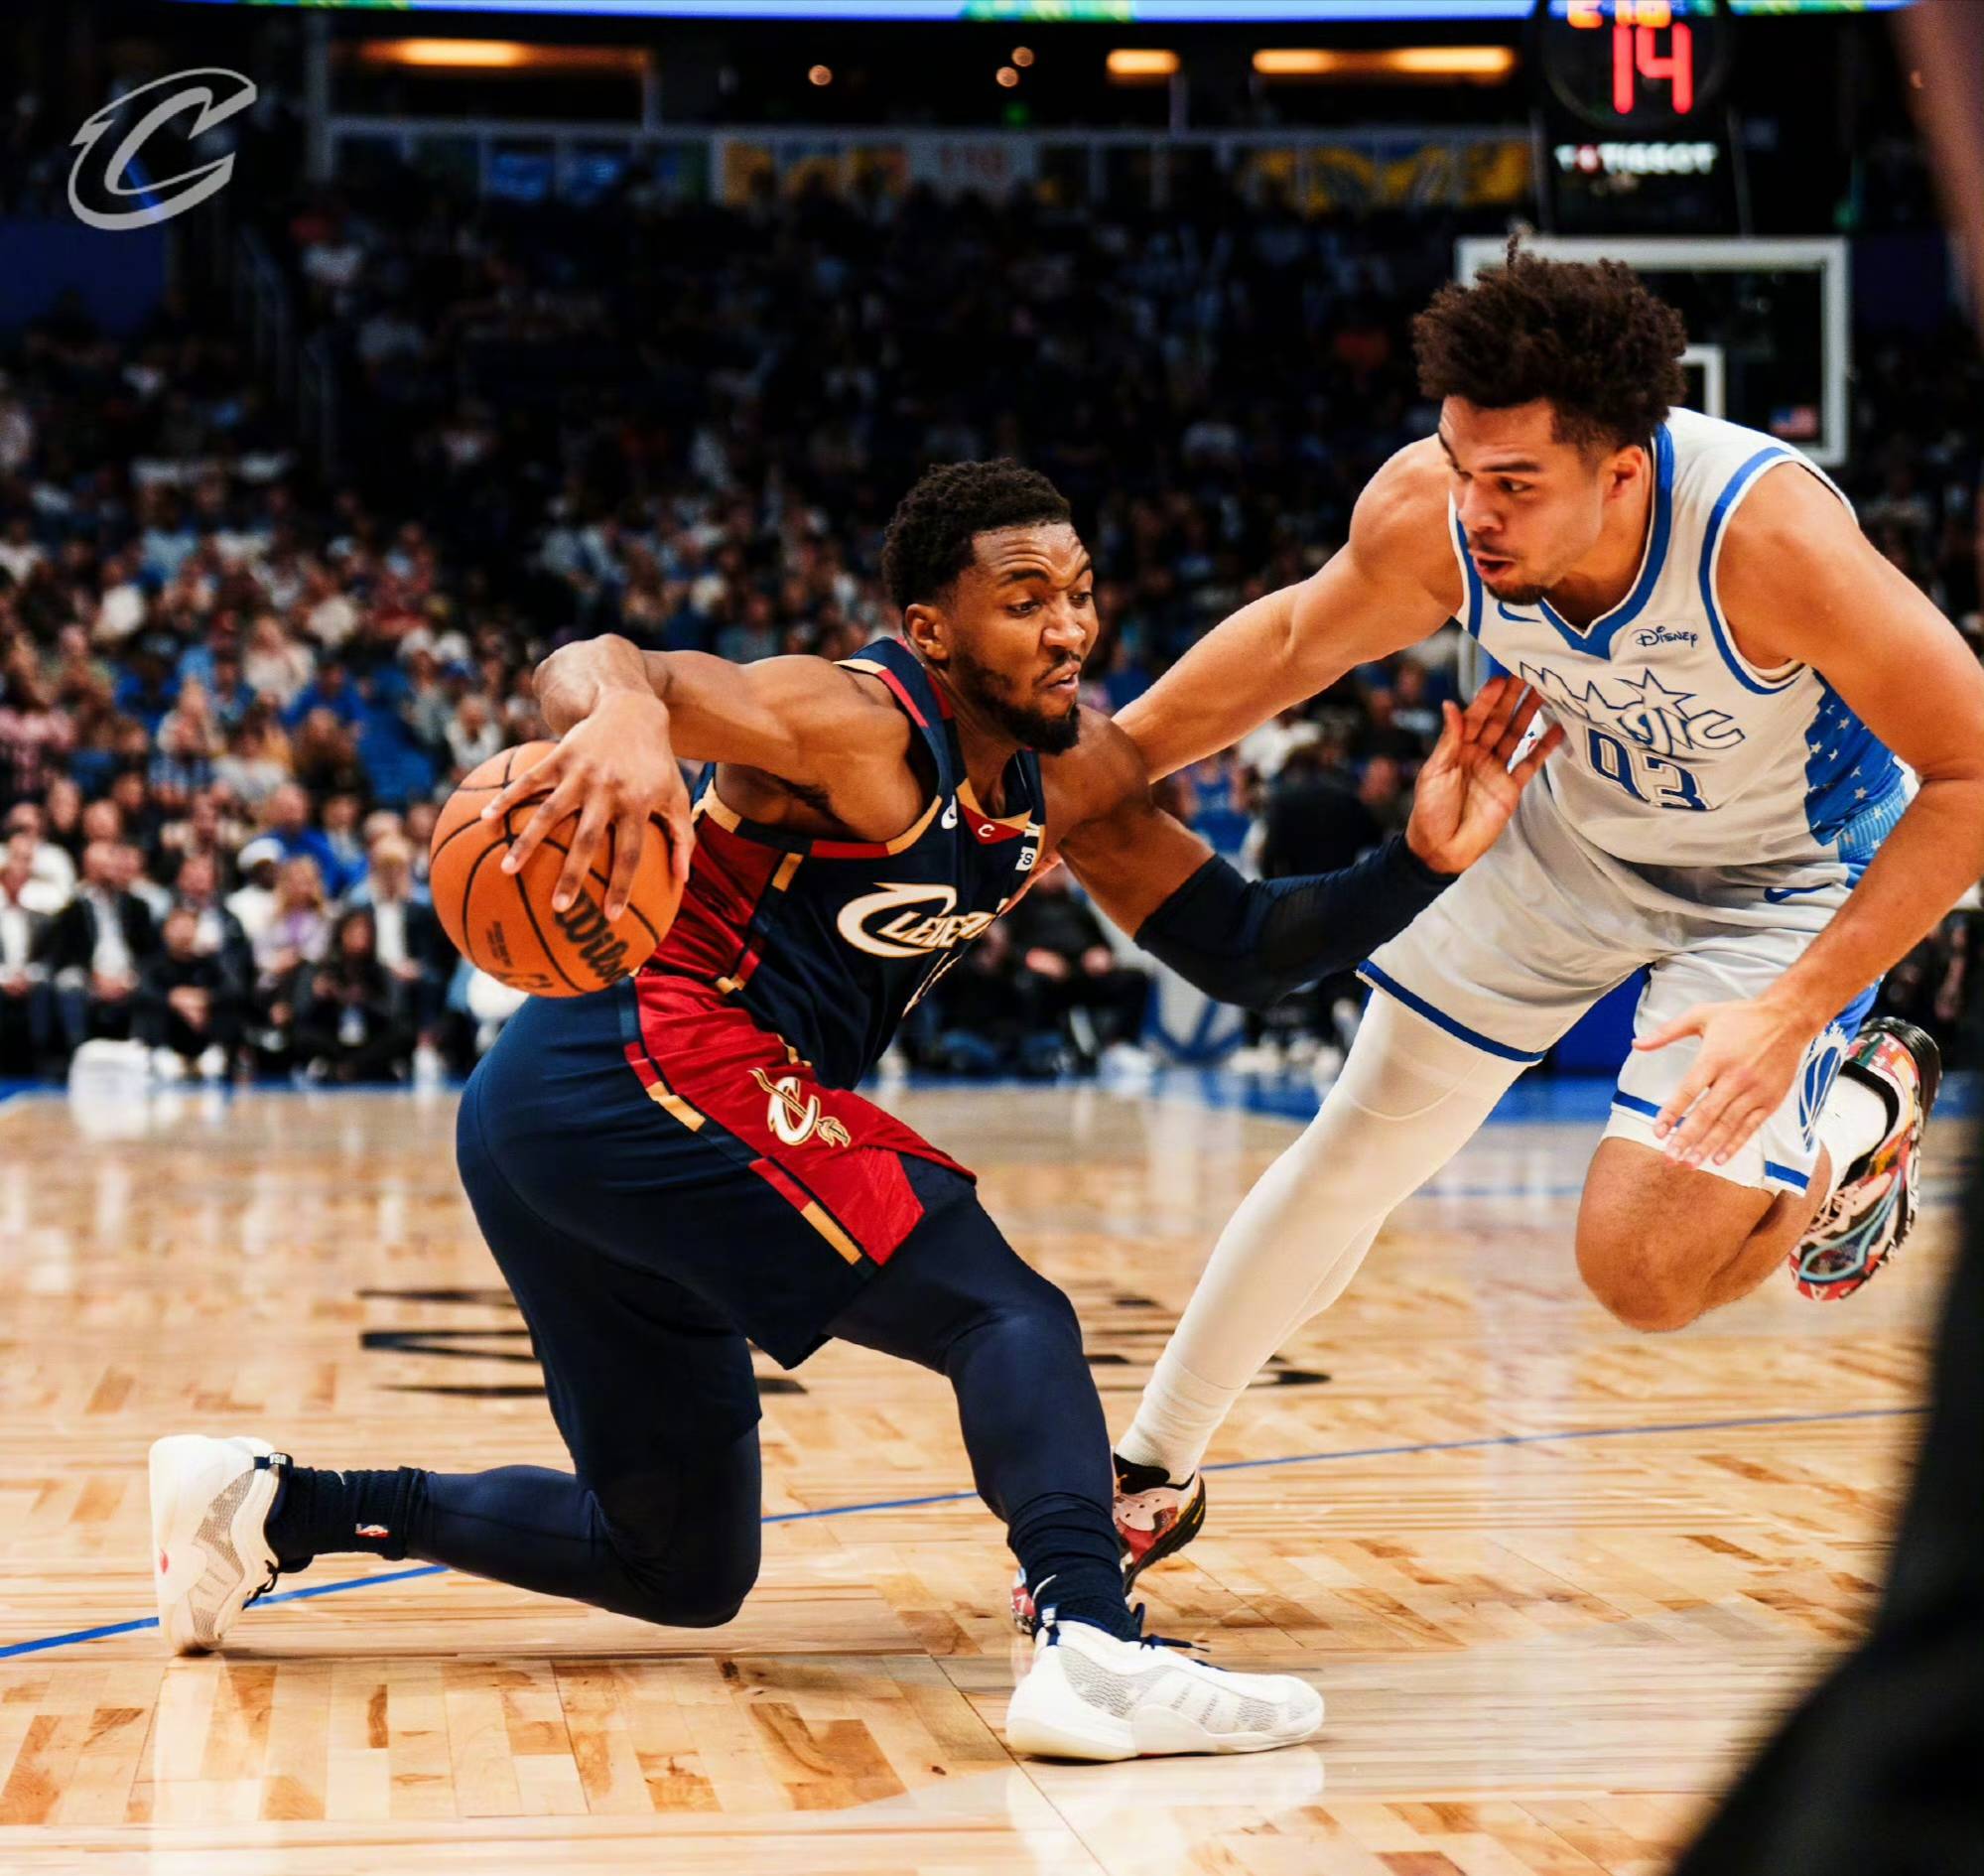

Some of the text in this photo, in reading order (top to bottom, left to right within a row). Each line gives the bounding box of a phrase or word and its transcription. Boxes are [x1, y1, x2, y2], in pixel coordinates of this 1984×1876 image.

[1612, 22, 1693, 115] 14
[1600, 142, 1720, 175] TISSOT
[1632, 625, 1699, 648] Disney
